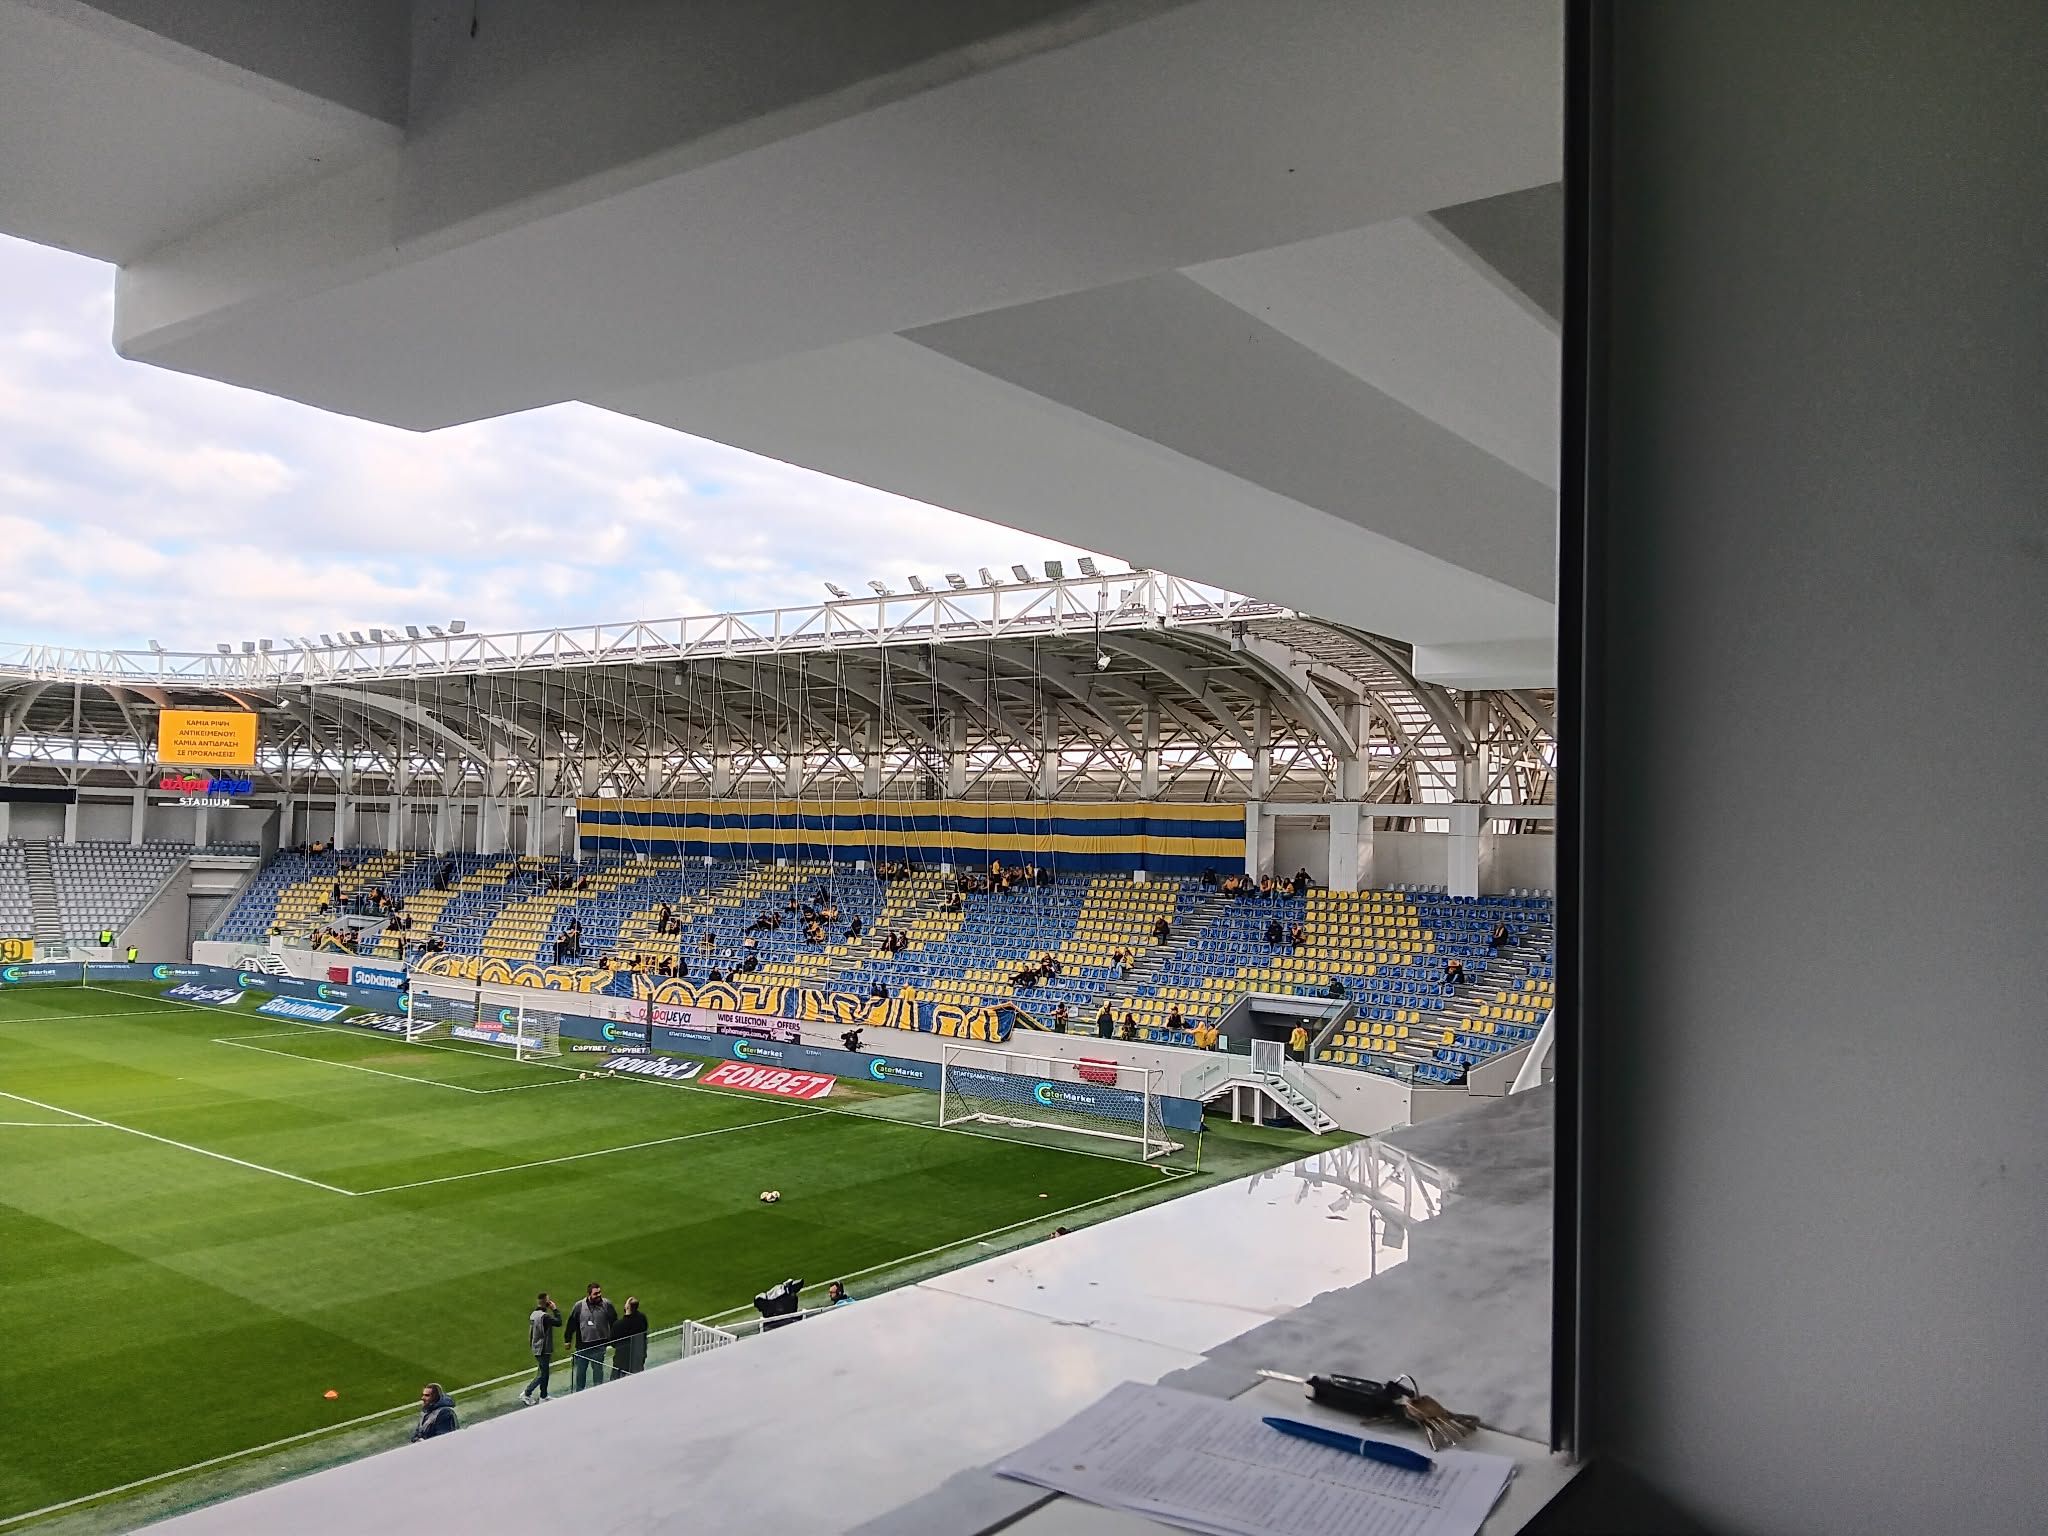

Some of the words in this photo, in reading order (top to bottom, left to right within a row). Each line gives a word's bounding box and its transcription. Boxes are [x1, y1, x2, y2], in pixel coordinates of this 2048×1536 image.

[180, 798, 230, 806] STADIUM
[639, 1006, 691, 1025] αφαμεγα
[718, 1013, 733, 1023] WIDE
[735, 1015, 767, 1027] SELECTION
[777, 1021, 800, 1031] OFFERS
[733, 1040, 783, 1060] CaterMarket
[603, 1056, 692, 1078] novibet
[869, 1058, 923, 1080] CaterMarket
[706, 1064, 826, 1095] FONBET
